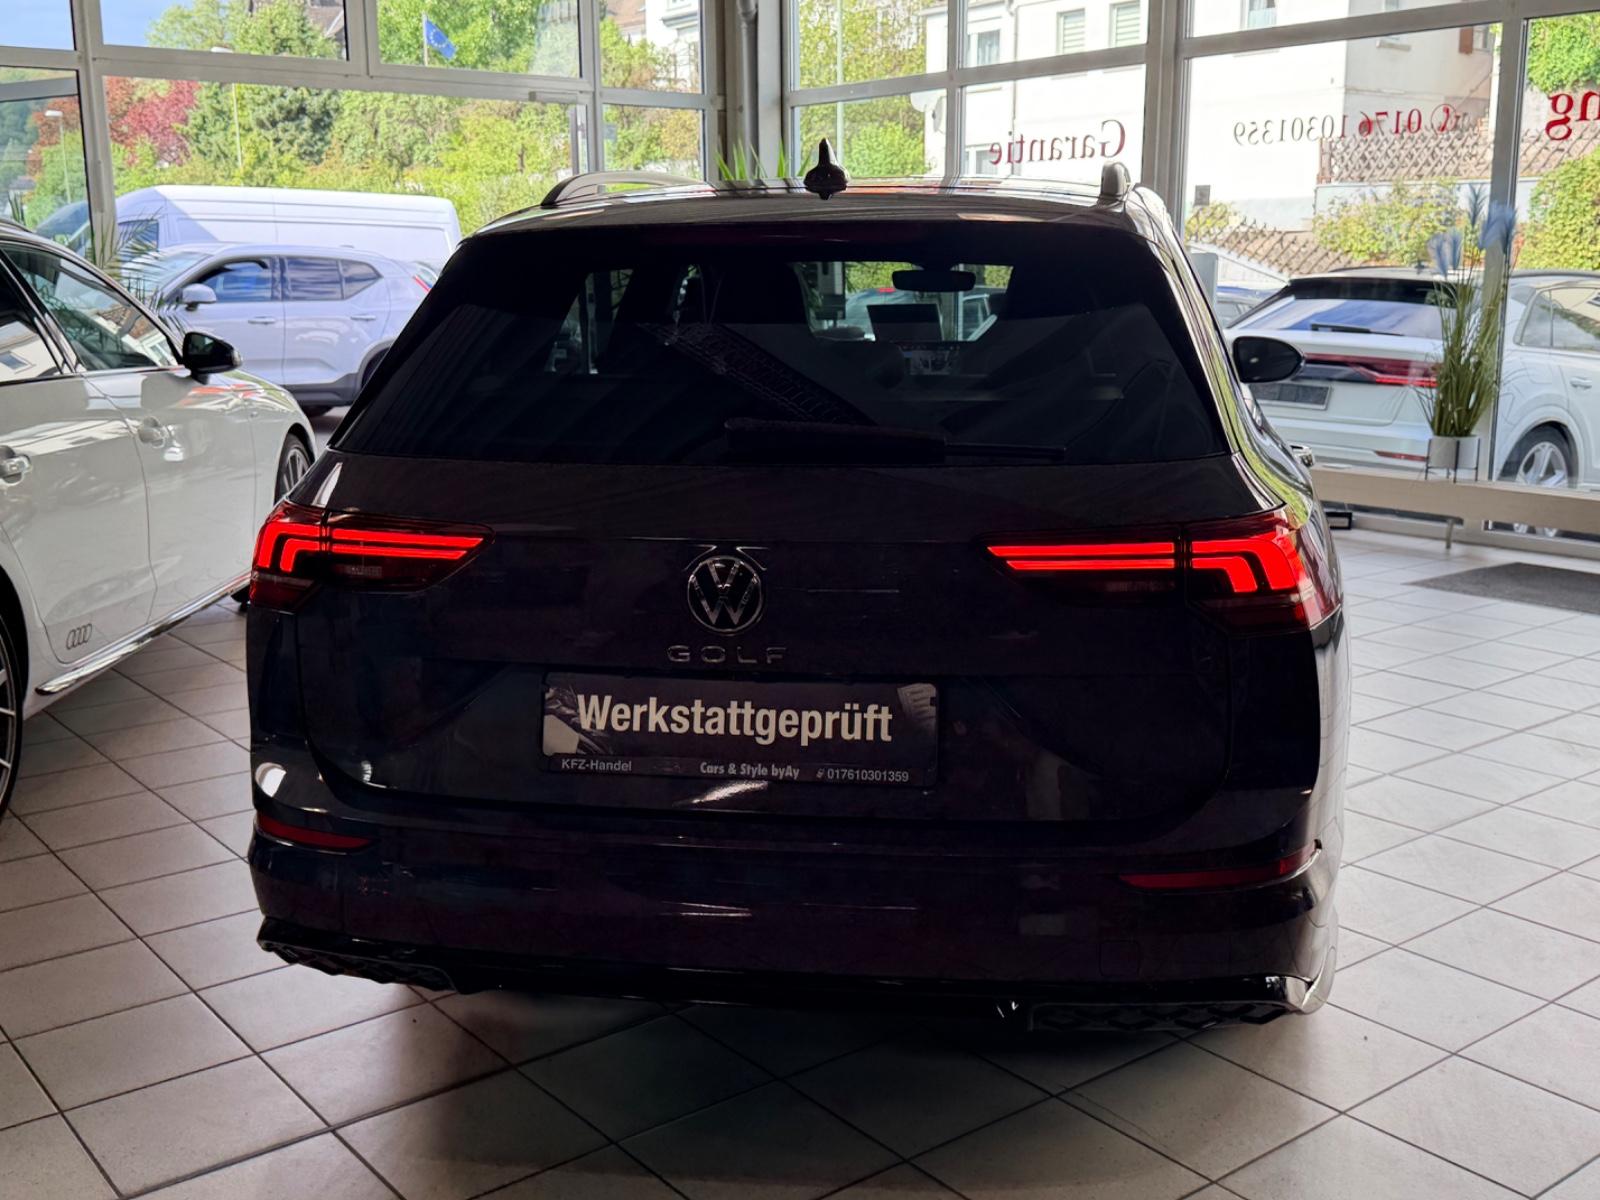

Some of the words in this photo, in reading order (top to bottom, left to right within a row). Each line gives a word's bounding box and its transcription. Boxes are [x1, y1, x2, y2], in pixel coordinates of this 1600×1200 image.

[667, 644, 787, 663] GOLF
[577, 694, 893, 747] Werkstattgeprüft
[561, 758, 633, 772] KFZ-Handel
[700, 761, 726, 775] Cars
[727, 763, 737, 775] &
[740, 762, 768, 777] Style
[771, 765, 800, 780] byAy
[826, 768, 909, 783] 017610301359
